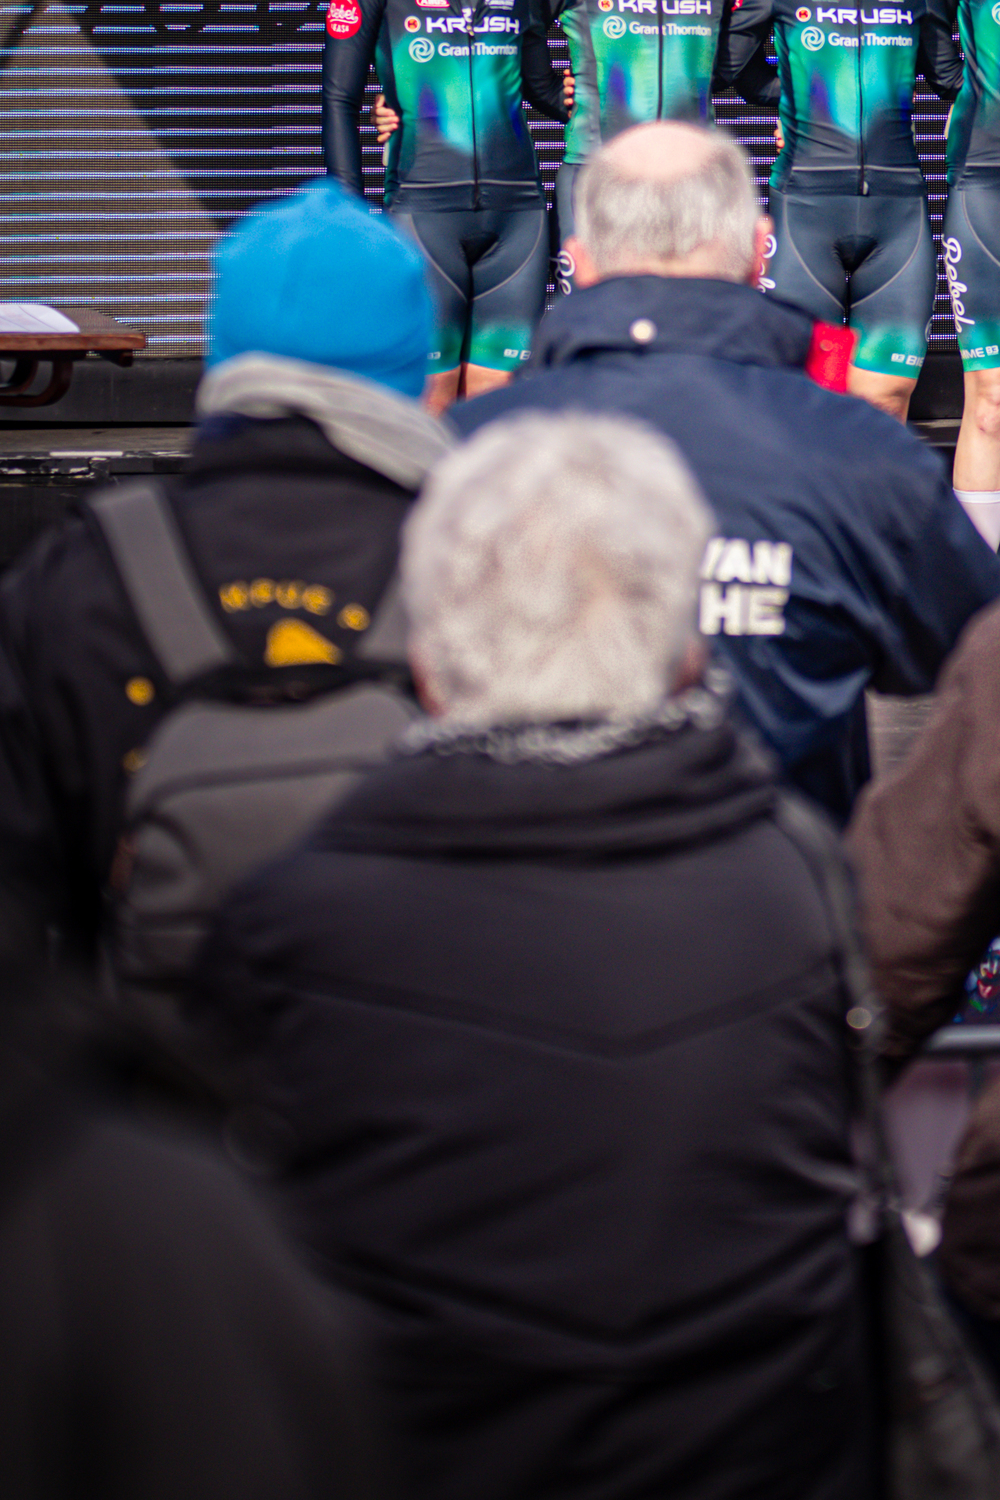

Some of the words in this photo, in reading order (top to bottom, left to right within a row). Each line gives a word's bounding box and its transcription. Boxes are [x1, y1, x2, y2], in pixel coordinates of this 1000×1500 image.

[817, 7, 912, 24] KRUSH
[666, 23, 712, 36] Thornton
[864, 33, 912, 46] Thornton
[941, 236, 976, 333] Rebel
